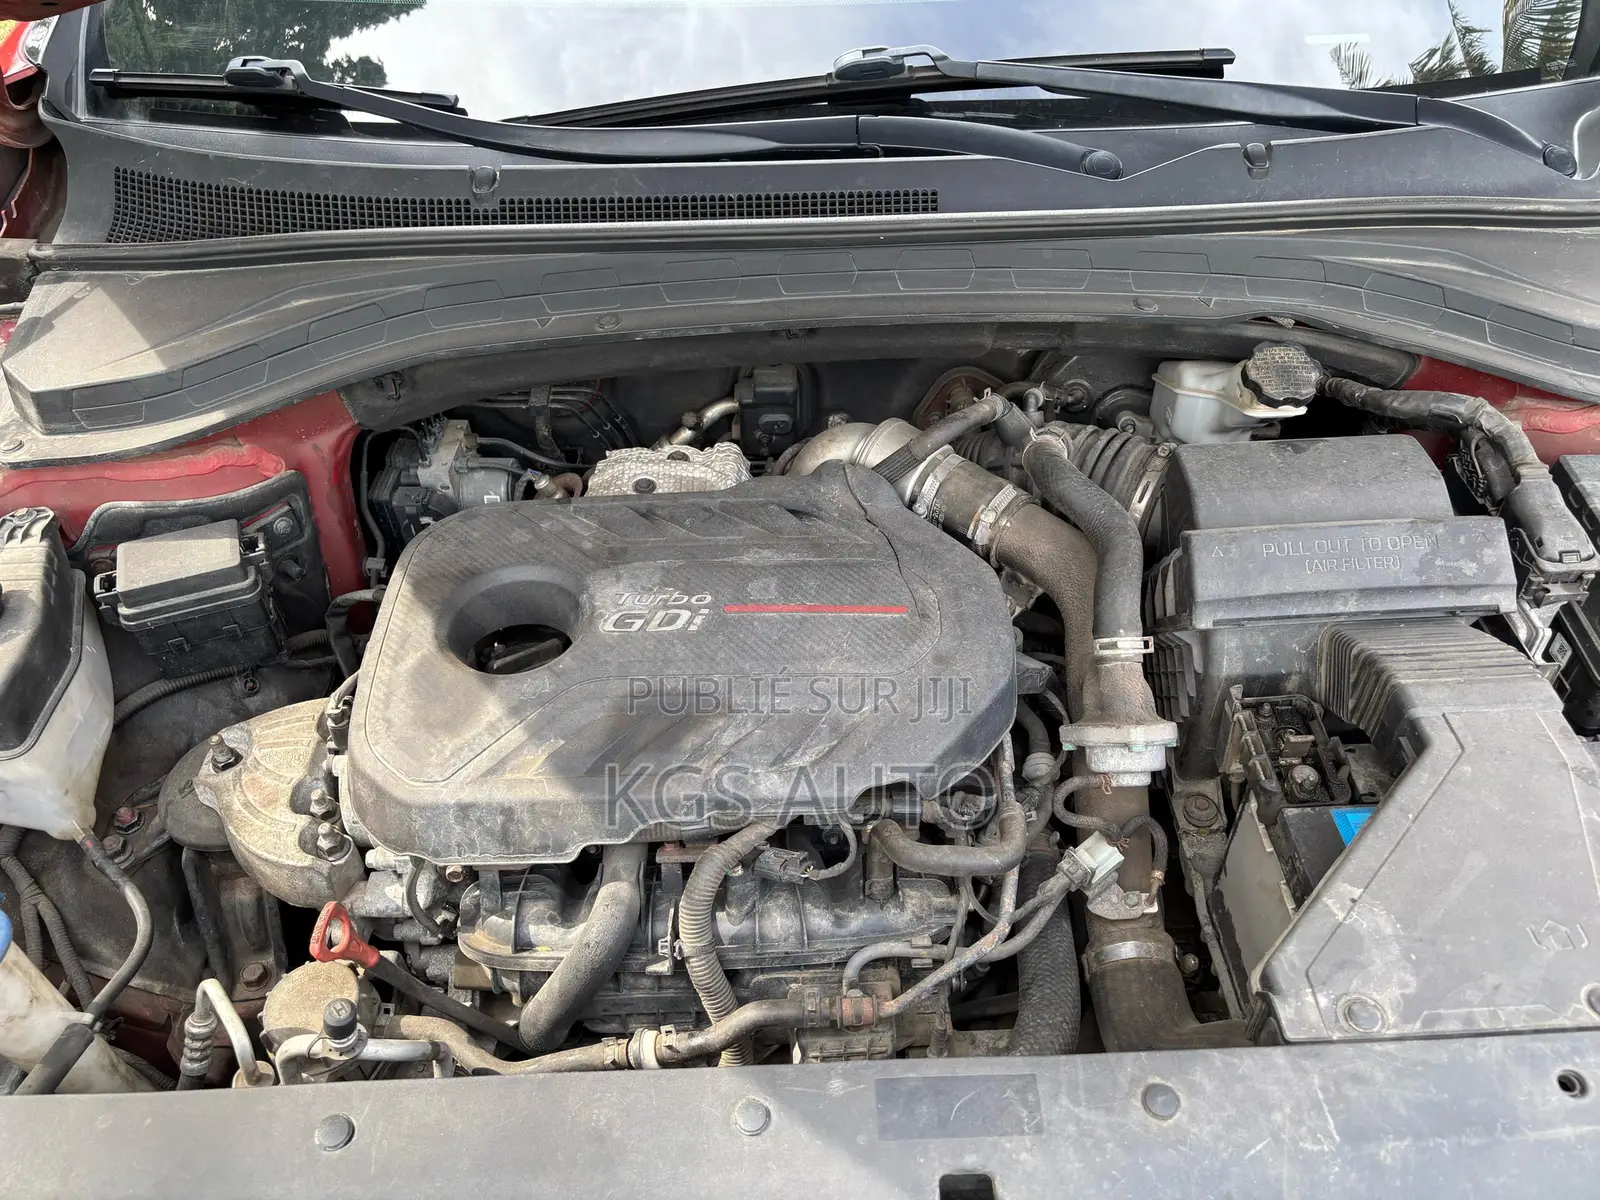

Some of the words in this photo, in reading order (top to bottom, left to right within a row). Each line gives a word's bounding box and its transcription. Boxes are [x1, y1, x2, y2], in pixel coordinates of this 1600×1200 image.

[1262, 541, 1310, 557] PULL
[1314, 537, 1352, 554] OUT
[1360, 536, 1382, 551] TO
[1387, 533, 1440, 551] OPEN
[1305, 558, 1338, 574] (AIR
[1341, 554, 1401, 572] FILTER)
[614, 591, 712, 606] Turbo
[601, 608, 711, 632] GDi
